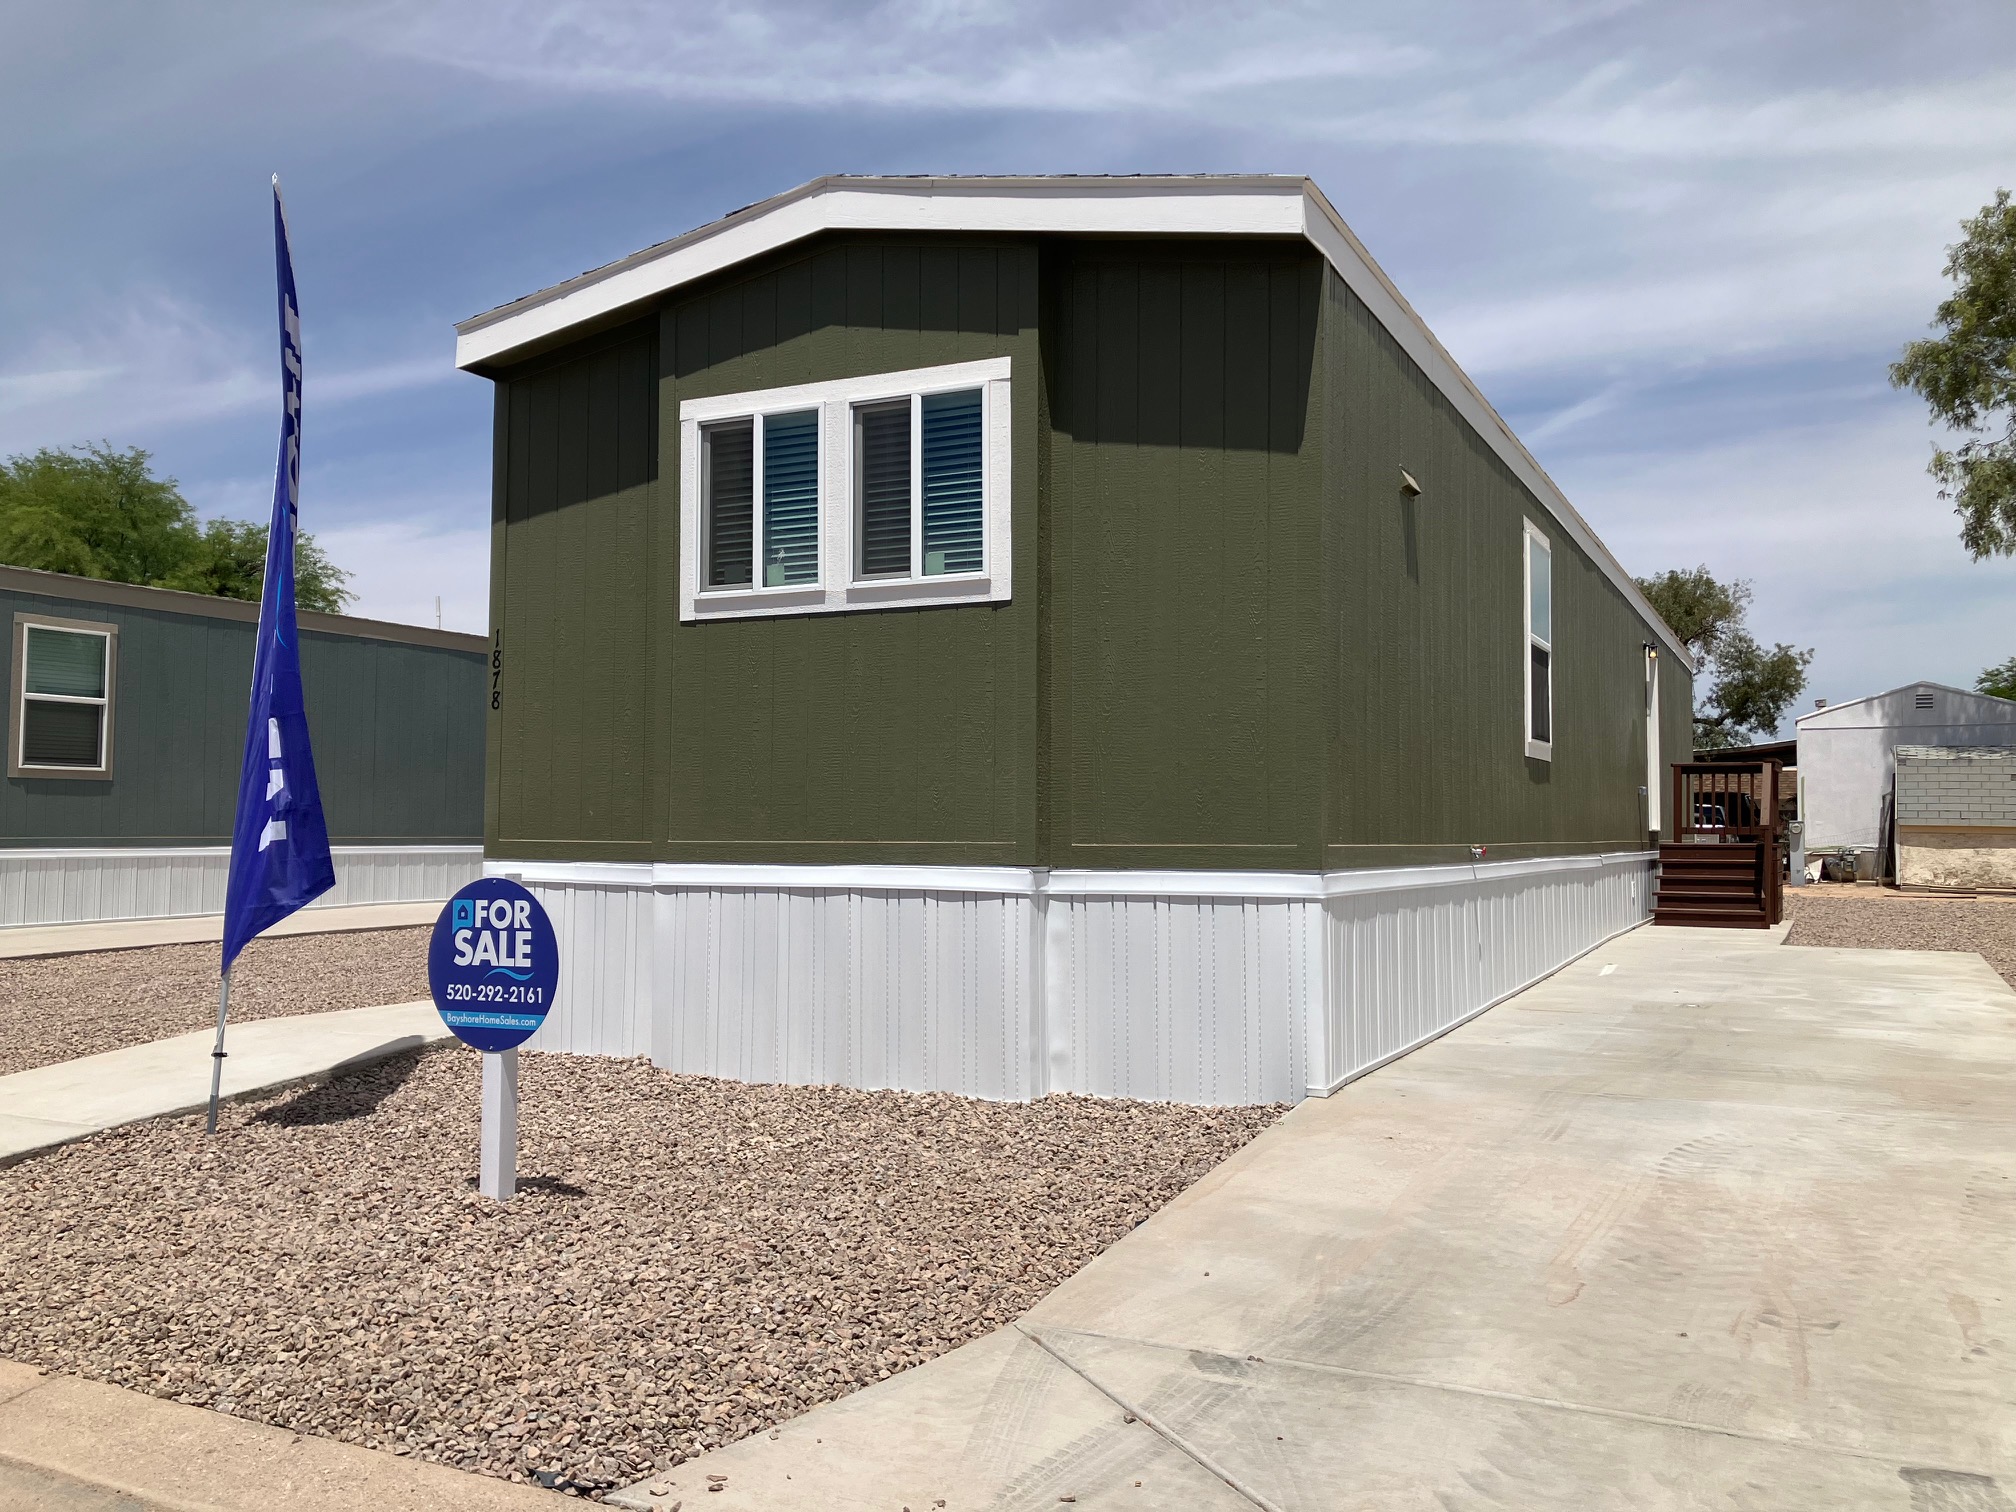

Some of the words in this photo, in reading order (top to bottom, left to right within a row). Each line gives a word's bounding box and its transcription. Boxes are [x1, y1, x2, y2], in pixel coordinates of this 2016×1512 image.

[492, 629, 501, 710] 1878
[475, 899, 532, 929] FOR
[453, 929, 532, 967] SALE
[446, 984, 542, 1004] 520-292-2161
[446, 1013, 536, 1026] BayshoreHomeSales.com
